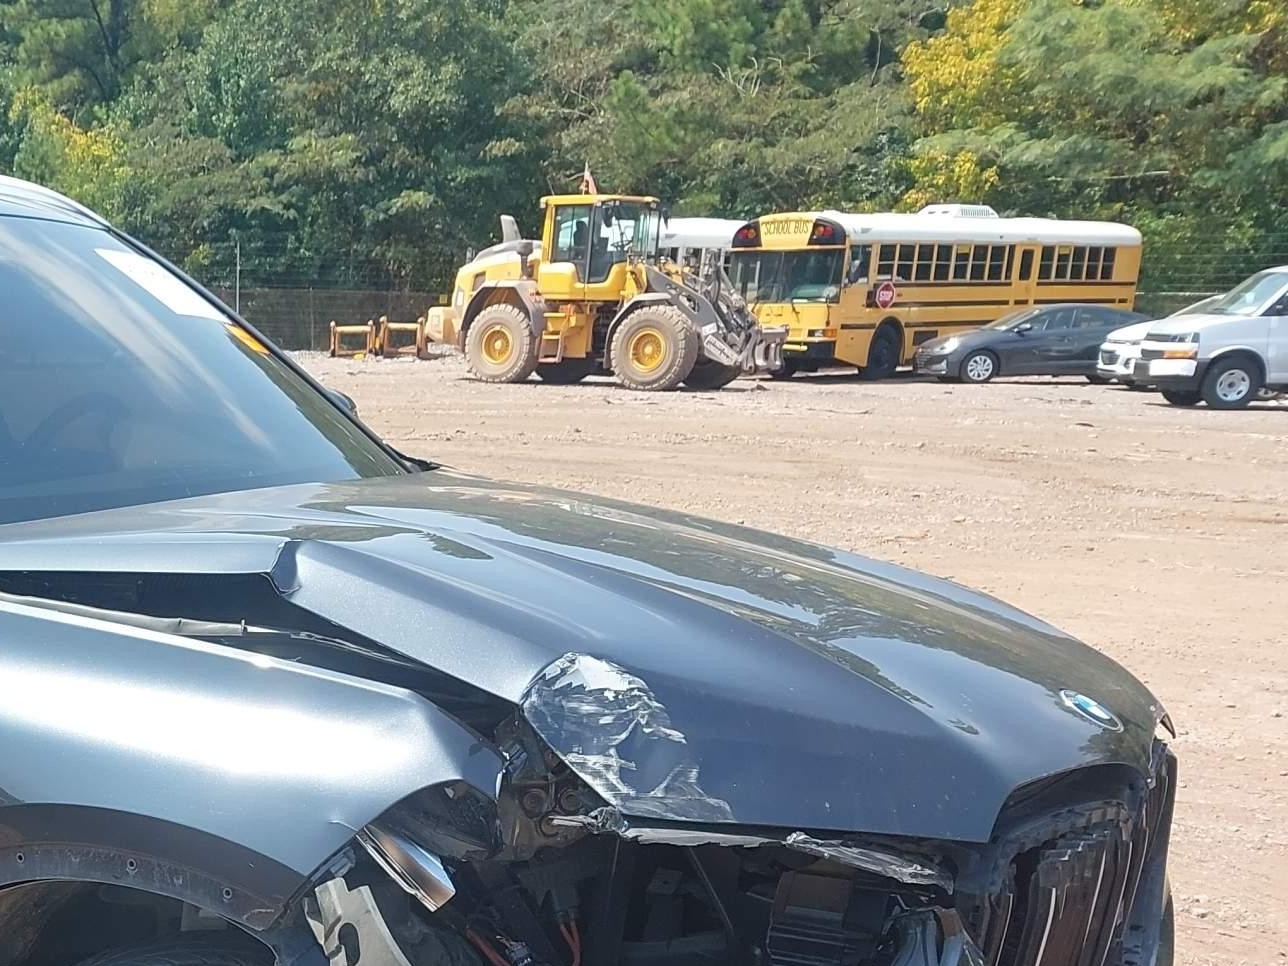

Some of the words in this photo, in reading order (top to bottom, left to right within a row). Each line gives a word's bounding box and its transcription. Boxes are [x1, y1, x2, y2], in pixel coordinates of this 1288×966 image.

[764, 221, 792, 236] SCHOOL
[793, 220, 810, 235] BUS
[879, 290, 893, 301] STOP
